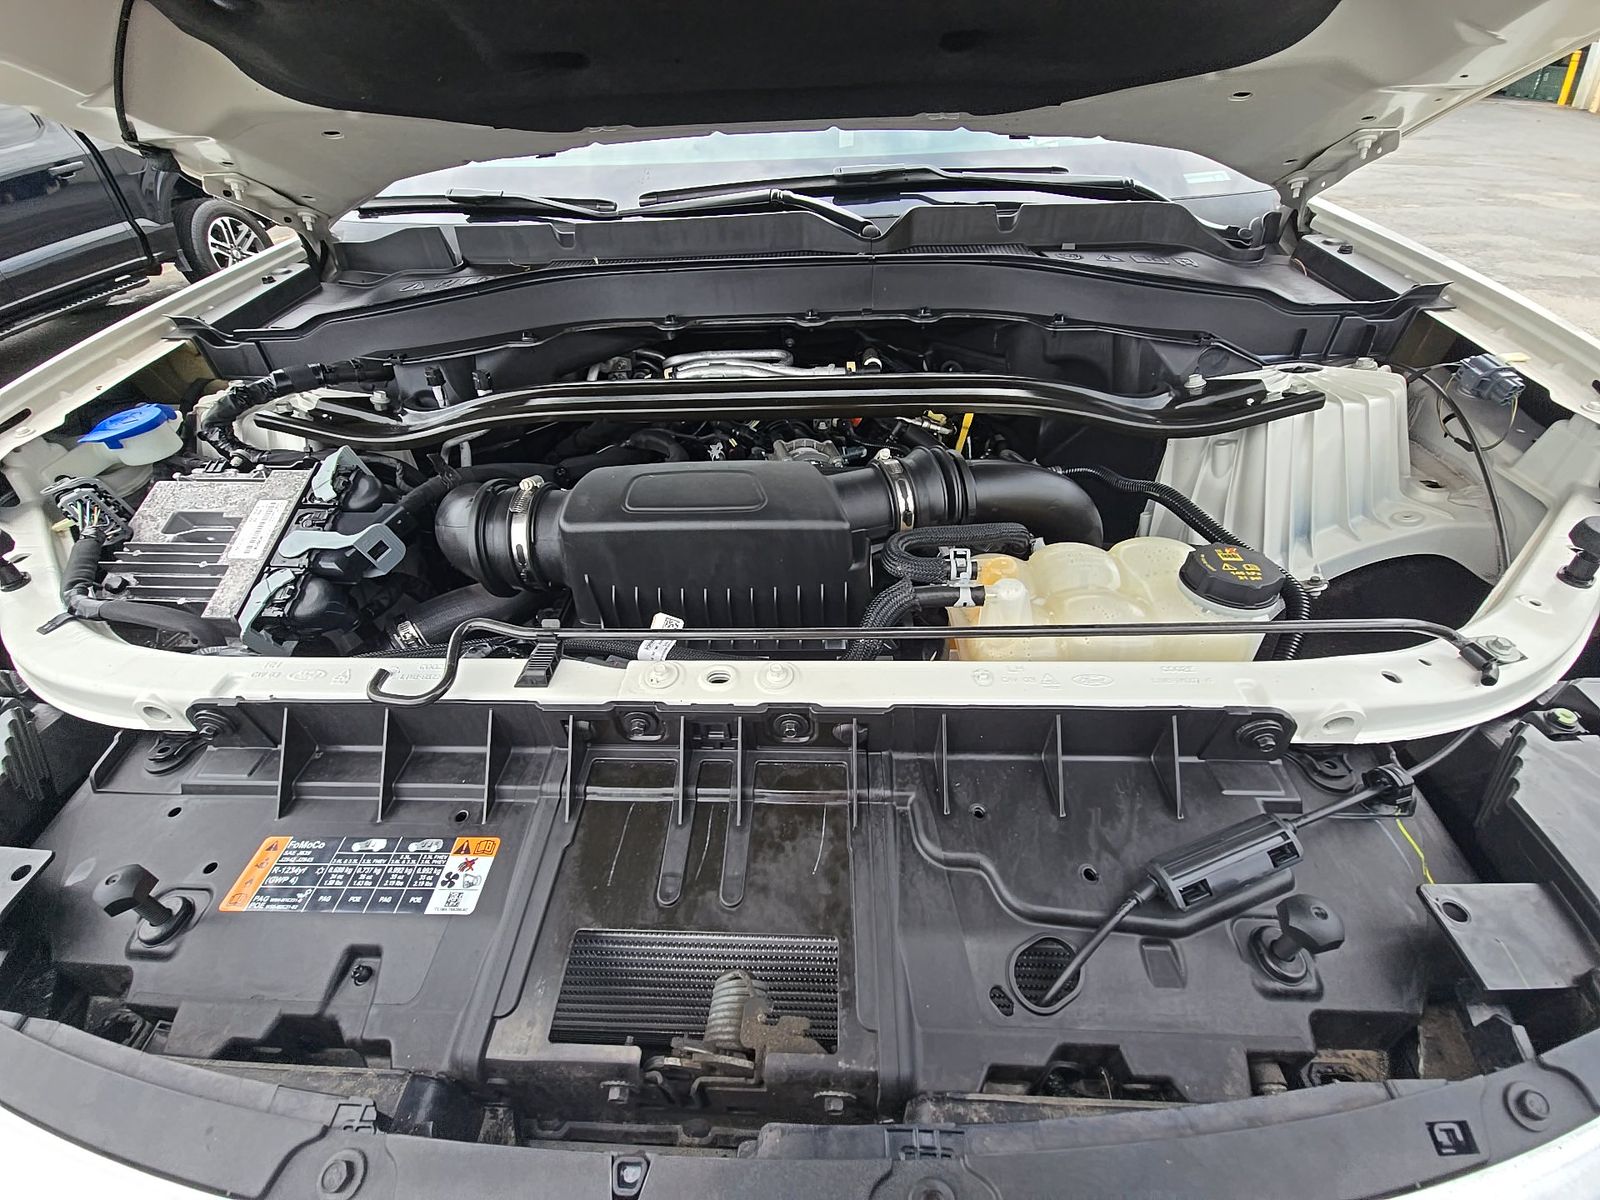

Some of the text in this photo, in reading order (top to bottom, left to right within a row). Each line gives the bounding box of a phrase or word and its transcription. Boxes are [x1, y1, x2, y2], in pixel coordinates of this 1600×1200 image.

[287, 840, 326, 849] FoMoCo
[271, 866, 309, 875] R-1234yf
[344, 866, 354, 875] kg
[373, 867, 382, 875] kg
[404, 867, 413, 875] kg
[433, 867, 442, 875] kg
[265, 876, 299, 885] (GWP 4)
